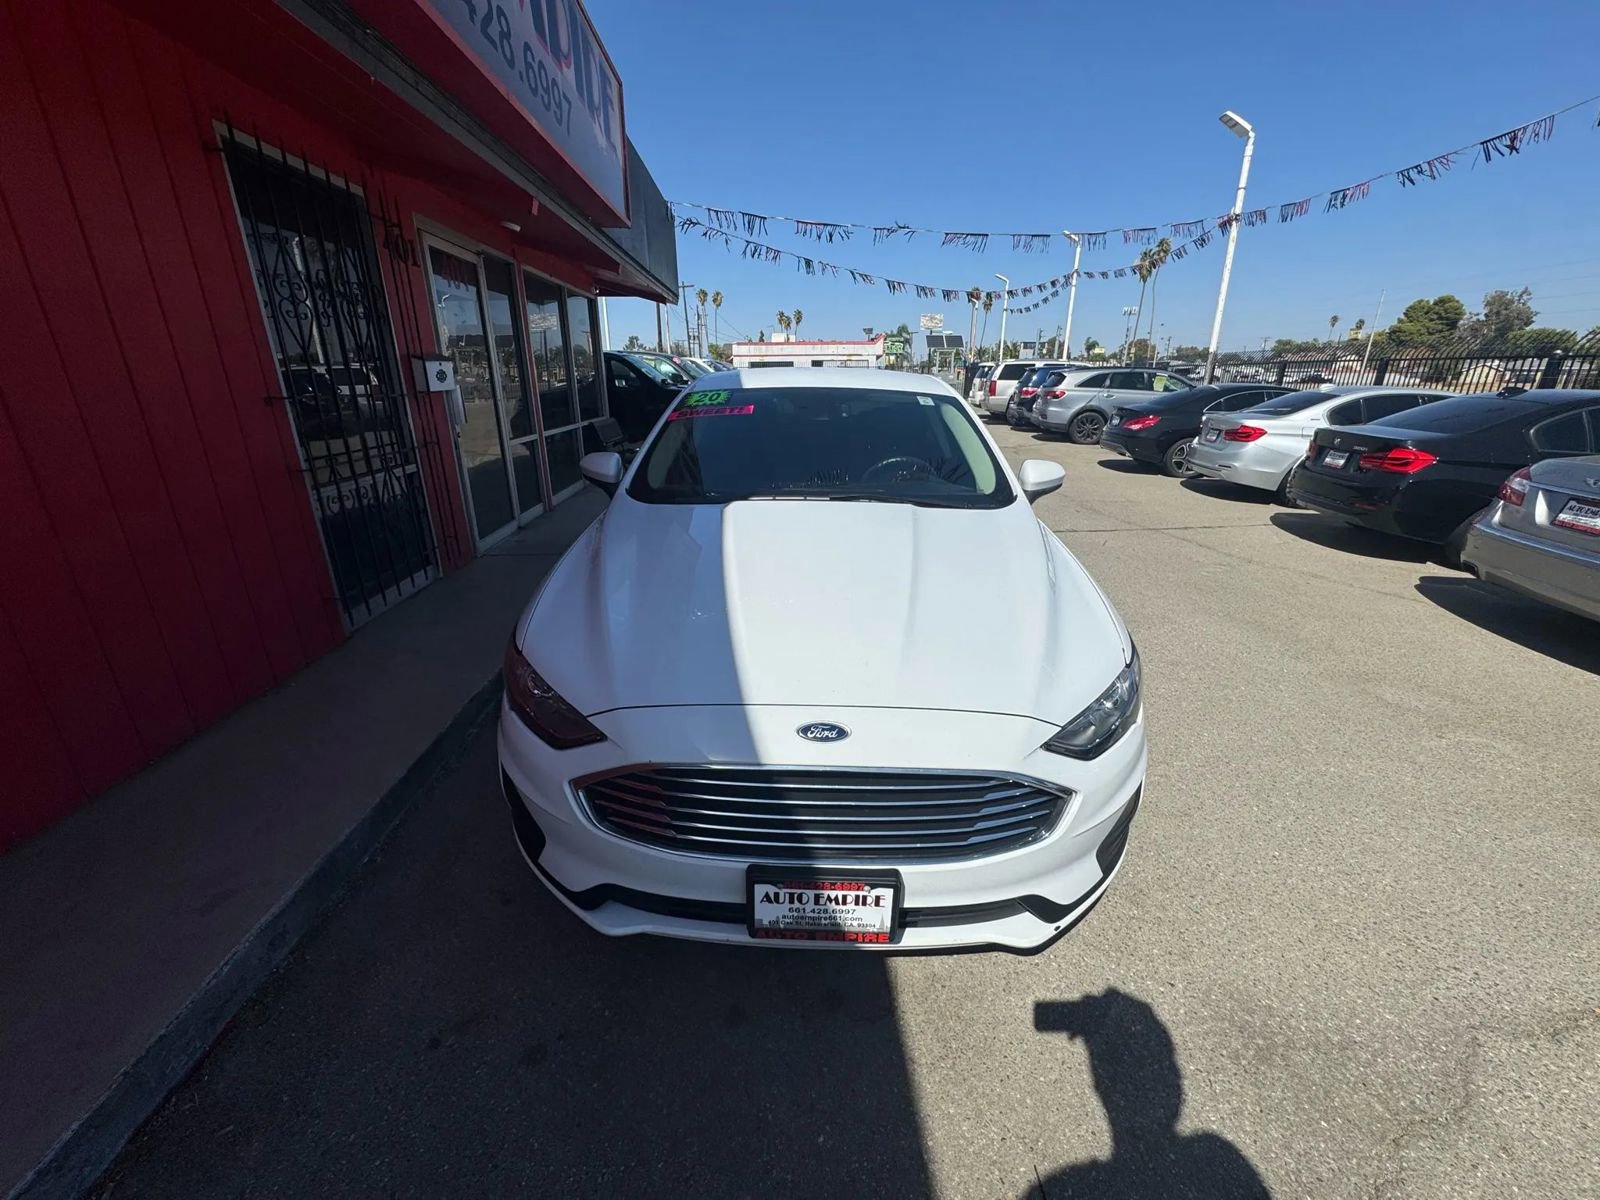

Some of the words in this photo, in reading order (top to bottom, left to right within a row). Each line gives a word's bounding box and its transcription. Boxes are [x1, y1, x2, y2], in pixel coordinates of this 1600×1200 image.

[693, 392, 722, 403] 20
[807, 725, 839, 738] Ford
[760, 891, 810, 905] AUTO
[814, 892, 886, 908] EMPIRE
[788, 907, 857, 915] 661.428.6997
[781, 914, 863, 922] autoempire661.com
